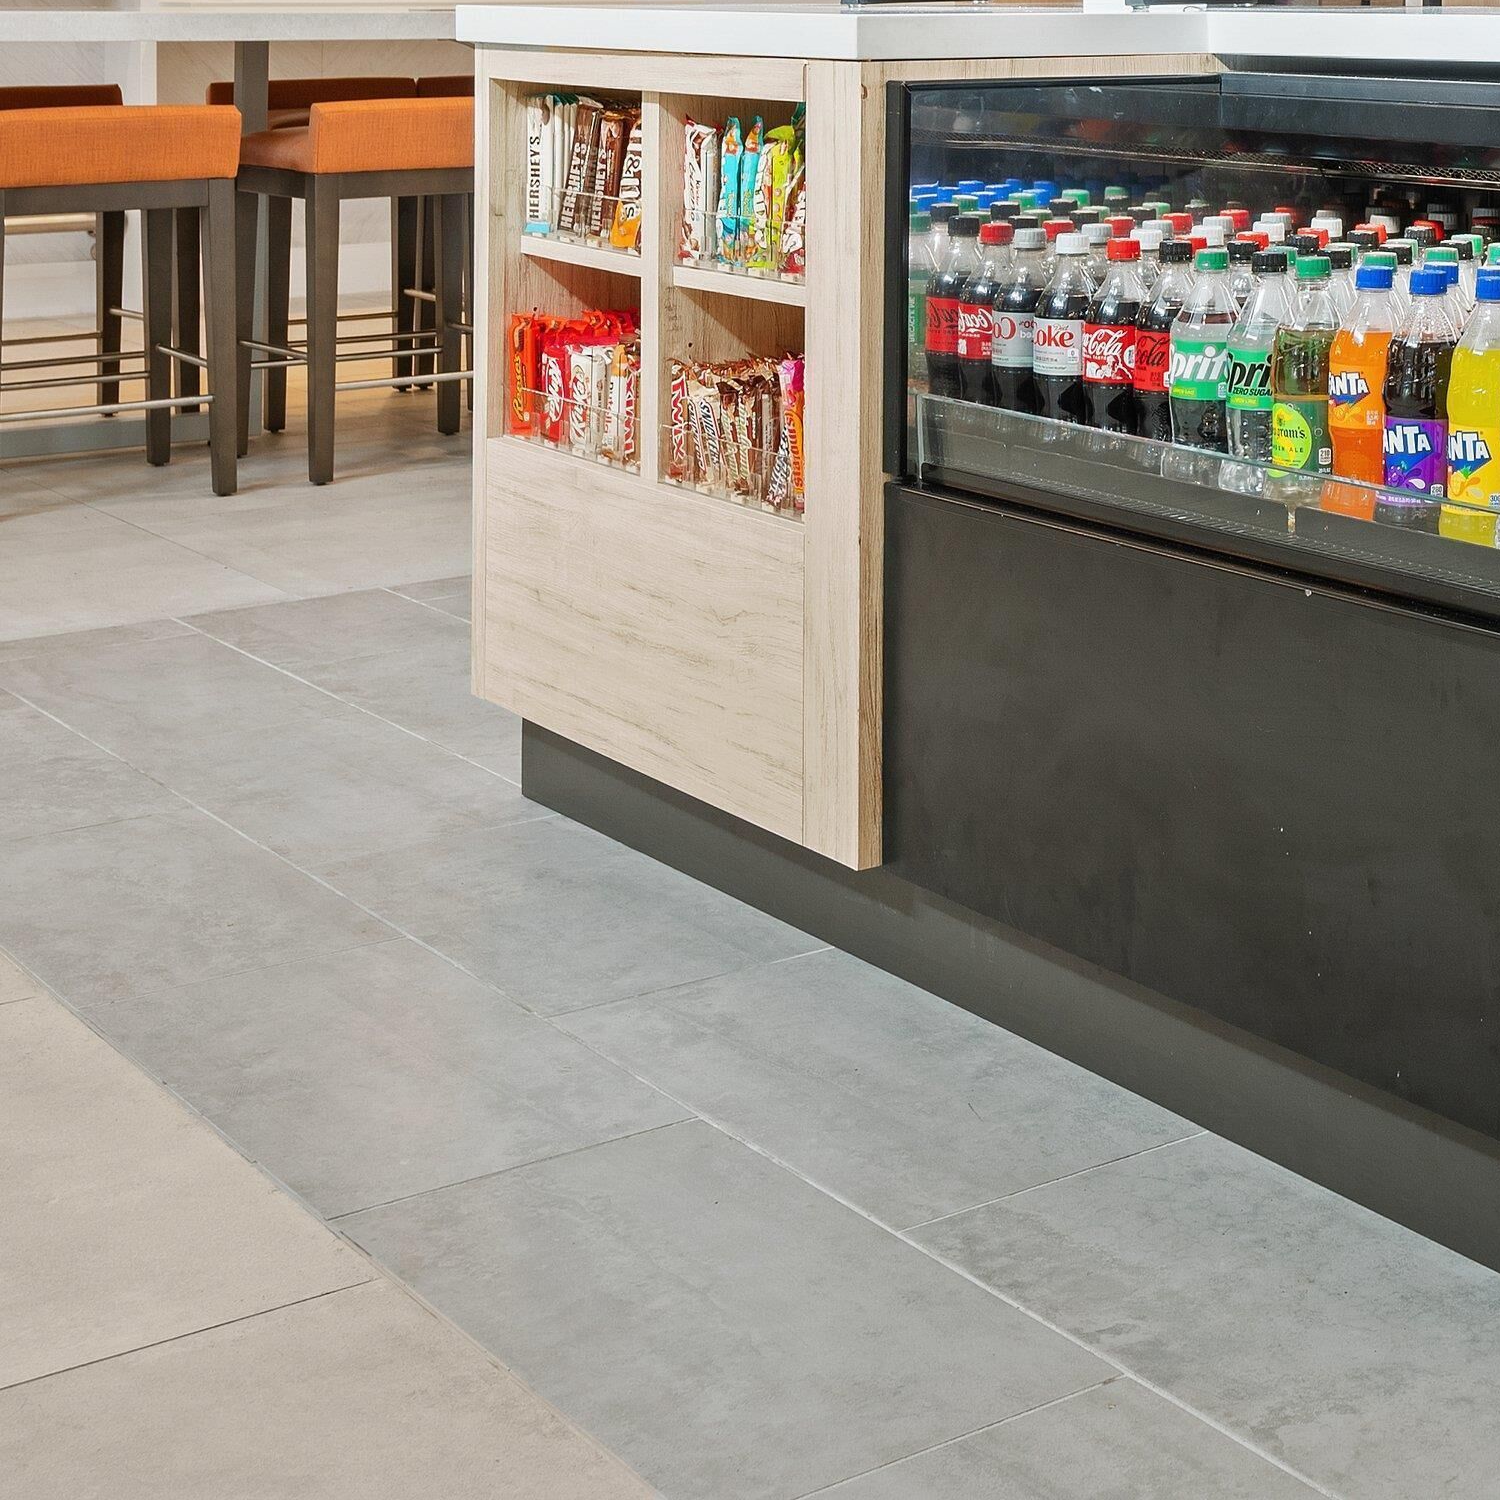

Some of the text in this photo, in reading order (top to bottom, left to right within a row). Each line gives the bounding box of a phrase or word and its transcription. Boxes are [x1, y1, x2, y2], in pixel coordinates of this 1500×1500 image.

[529, 135, 541, 219] HERSHEY'S
[560, 142, 583, 229] HERSHEY'S
[590, 148, 608, 232] HERSHEY'S
[1034, 325, 1075, 349] oke
[1170, 344, 1228, 386] prit
[1329, 371, 1369, 396] ANTA
[623, 367, 636, 456] TWIX
[1233, 386, 1273, 397] ZERO SUGA
[671, 374, 687, 462] TWIX
[700, 401, 720, 468] SNICKERS
[1320, 449, 1331, 457] 210
[1383, 425, 1432, 455] ANTA
[1449, 431, 1490, 462] NTA
